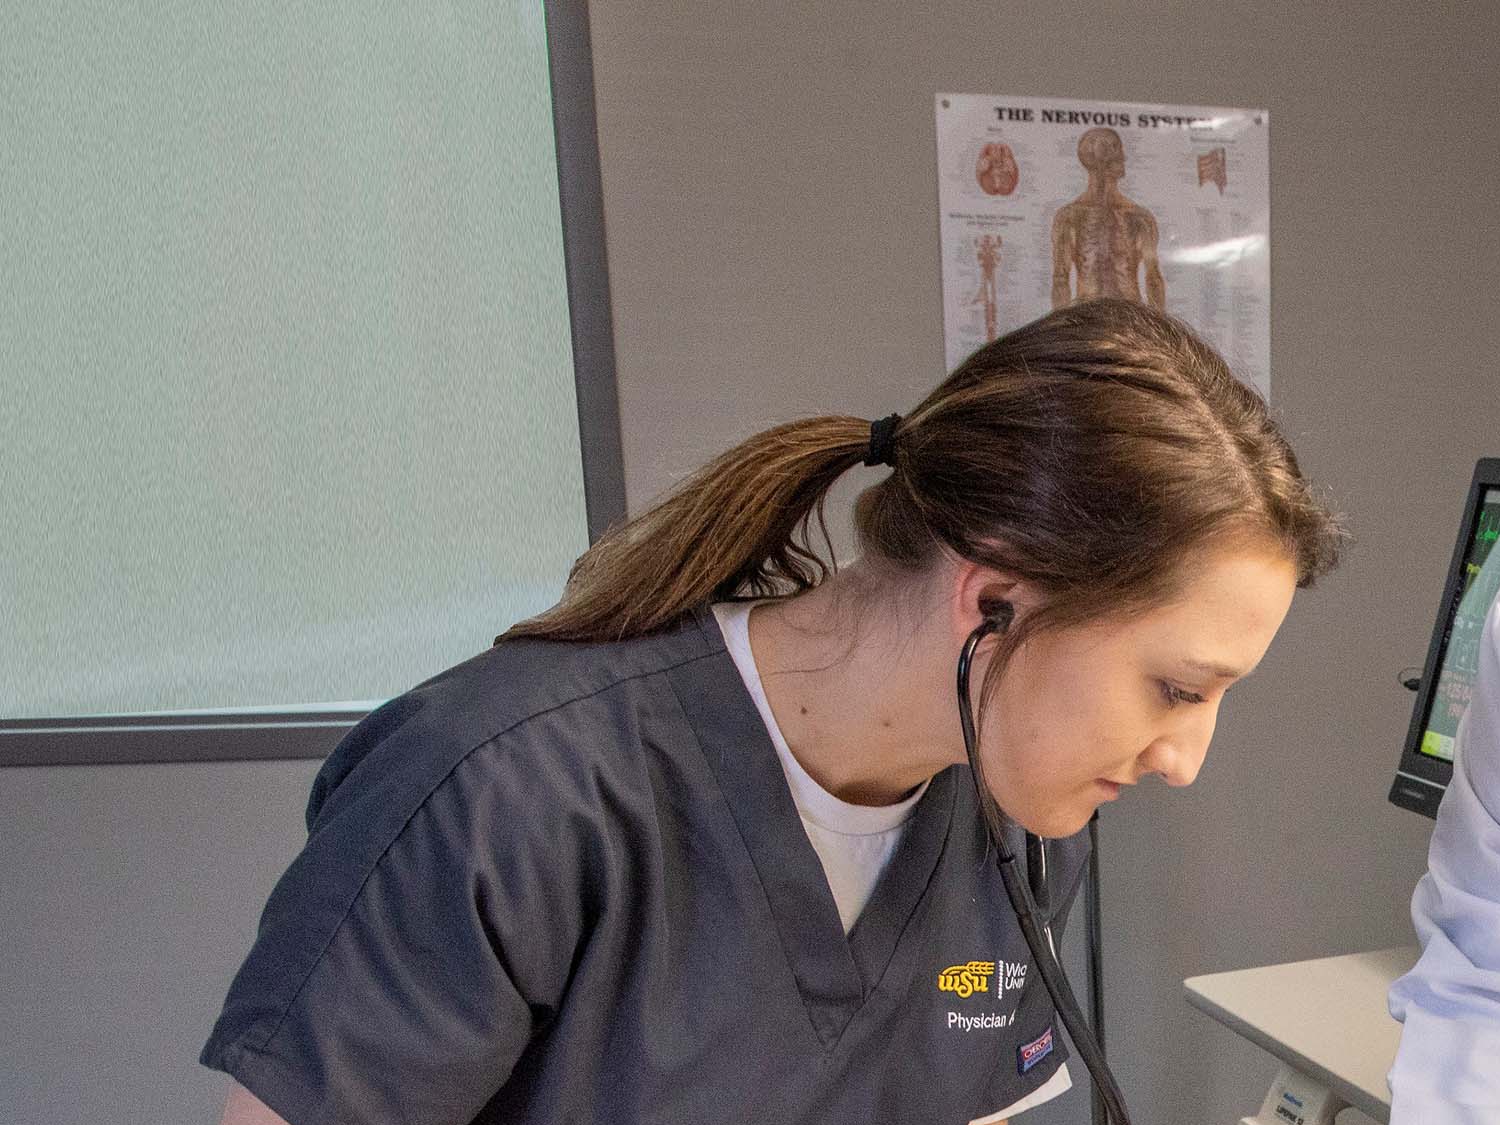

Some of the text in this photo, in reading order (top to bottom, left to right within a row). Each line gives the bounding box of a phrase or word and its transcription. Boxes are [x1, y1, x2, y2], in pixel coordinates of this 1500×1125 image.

[994, 106, 1035, 123] THE
[1041, 109, 1131, 127] NERVOUS
[947, 1012, 1007, 1032] Physician
